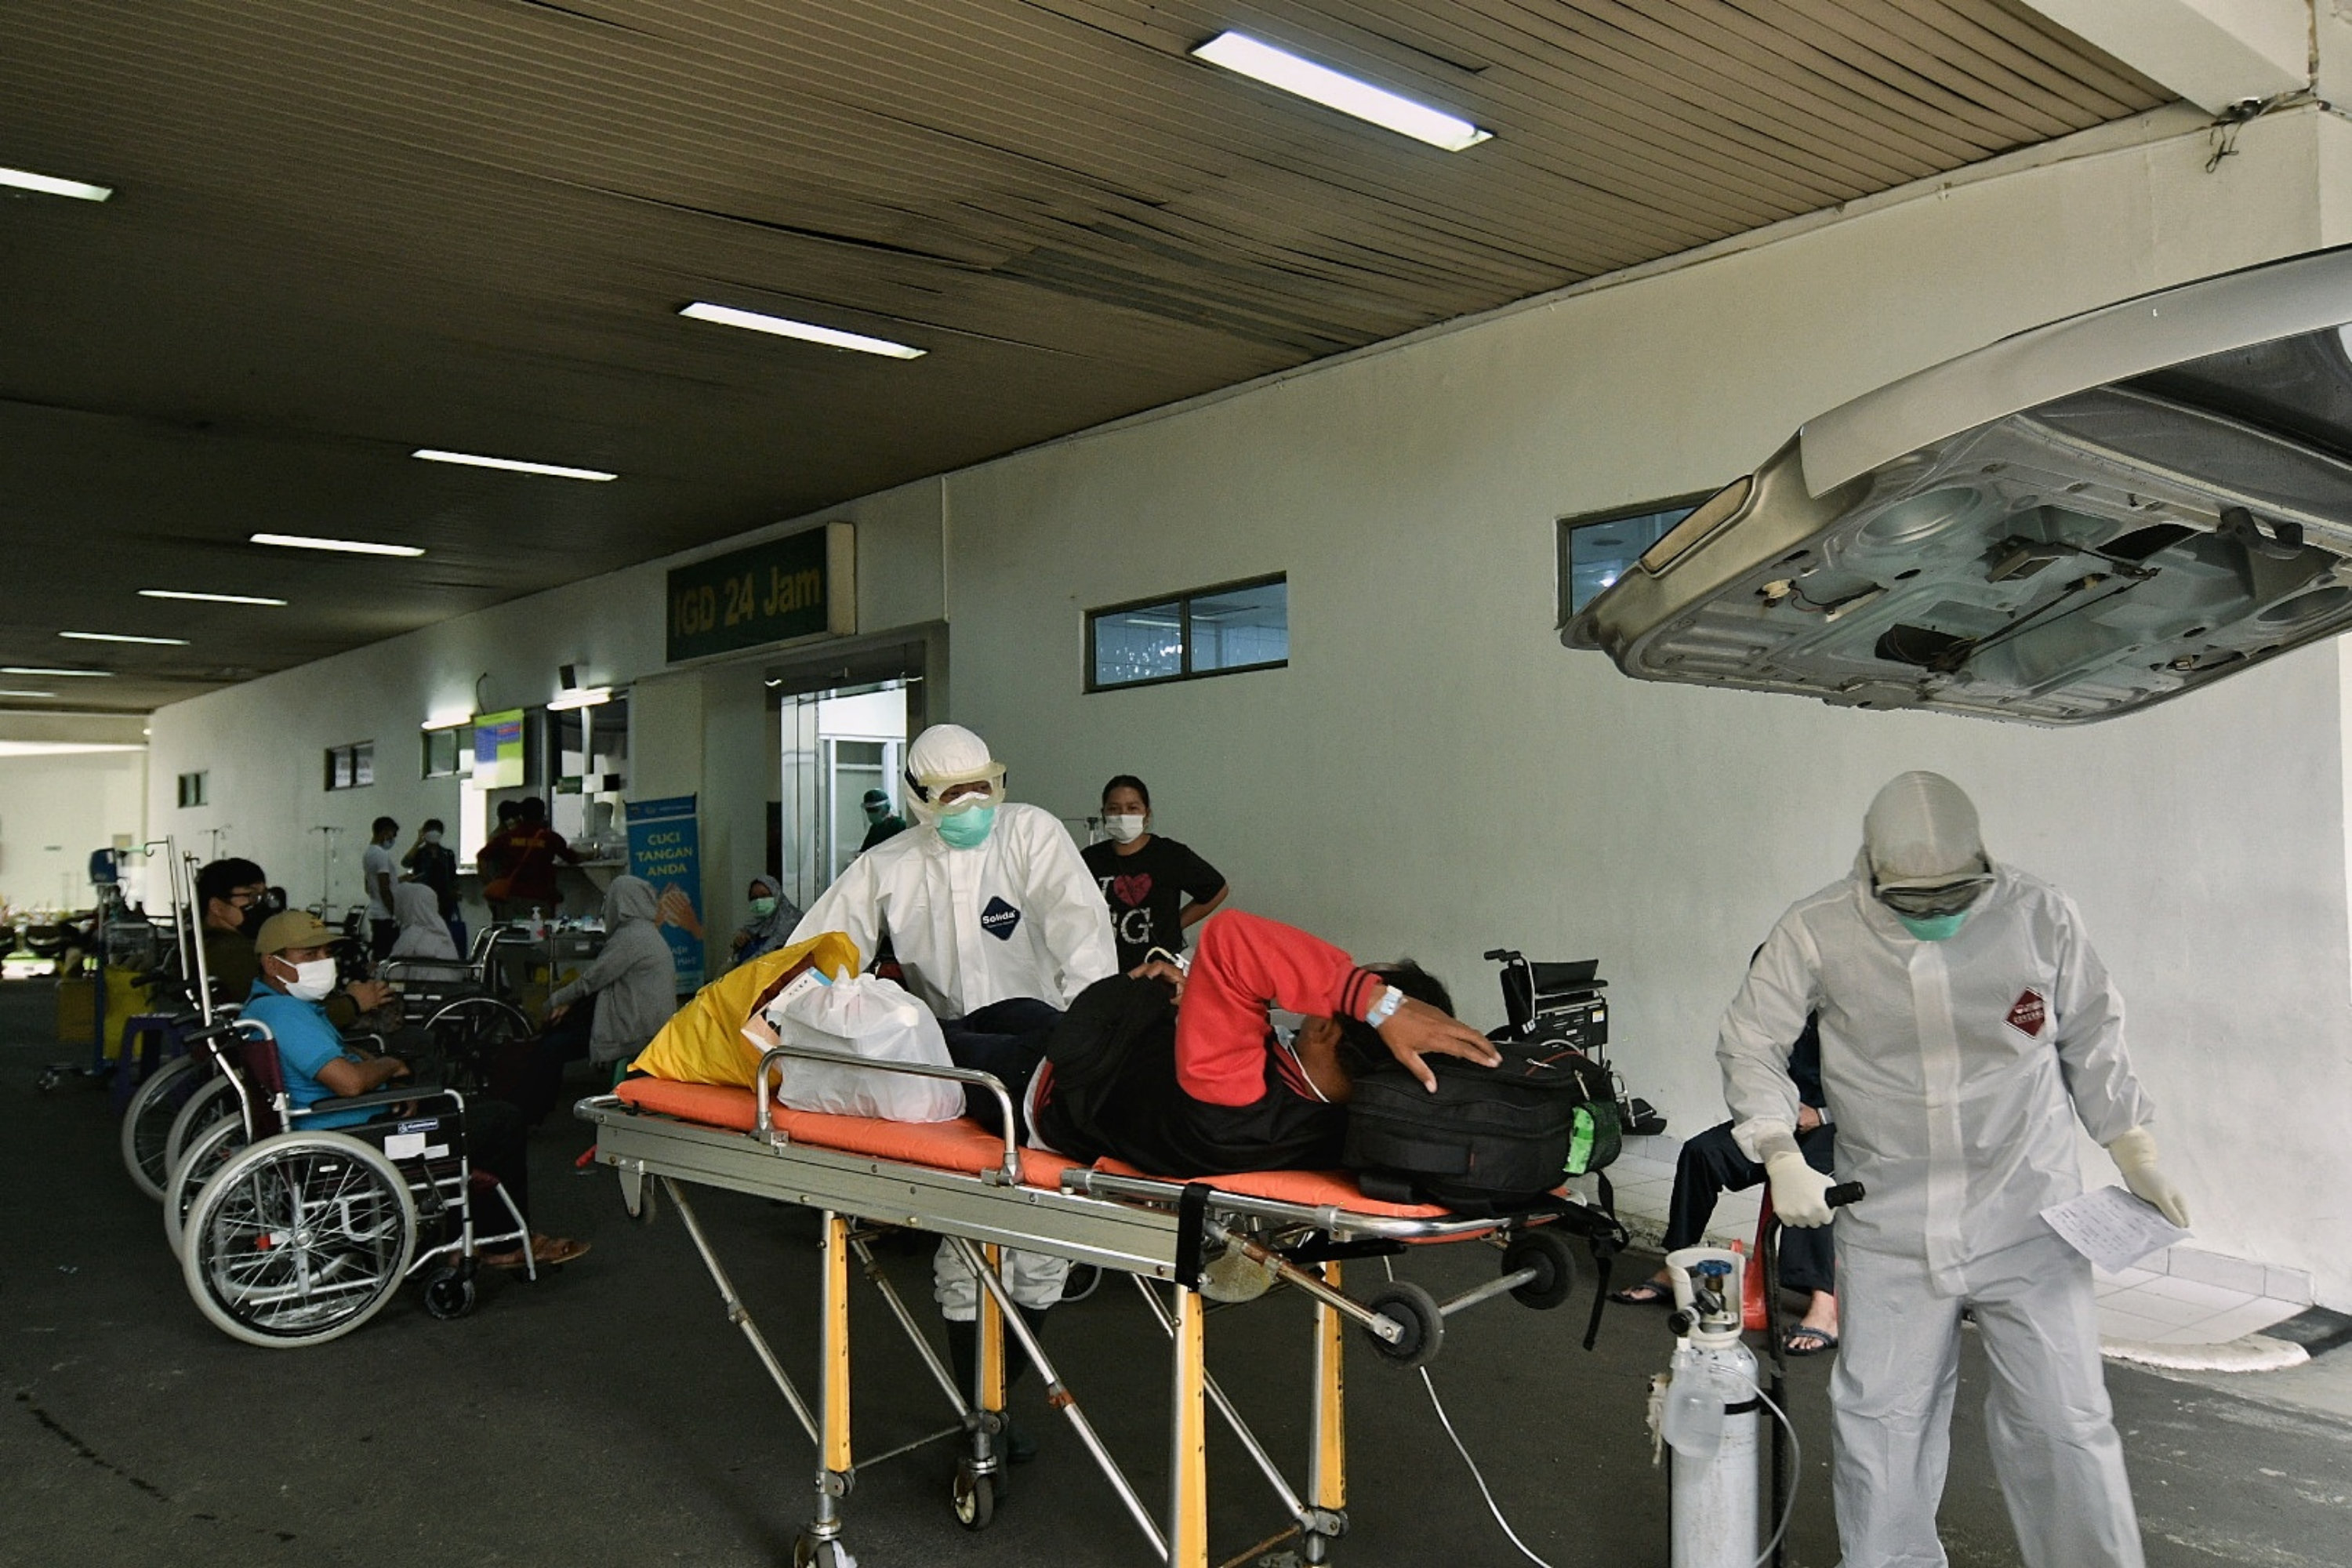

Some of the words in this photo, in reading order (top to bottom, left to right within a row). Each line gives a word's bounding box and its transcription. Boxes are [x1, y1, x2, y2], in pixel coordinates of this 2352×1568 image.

[673, 584, 716, 638] IGD
[724, 572, 755, 626] 24
[764, 564, 821, 616] Jam
[647, 832, 681, 846] CUCI
[636, 847, 693, 862] TANGAN
[647, 863, 688, 877] ANDA
